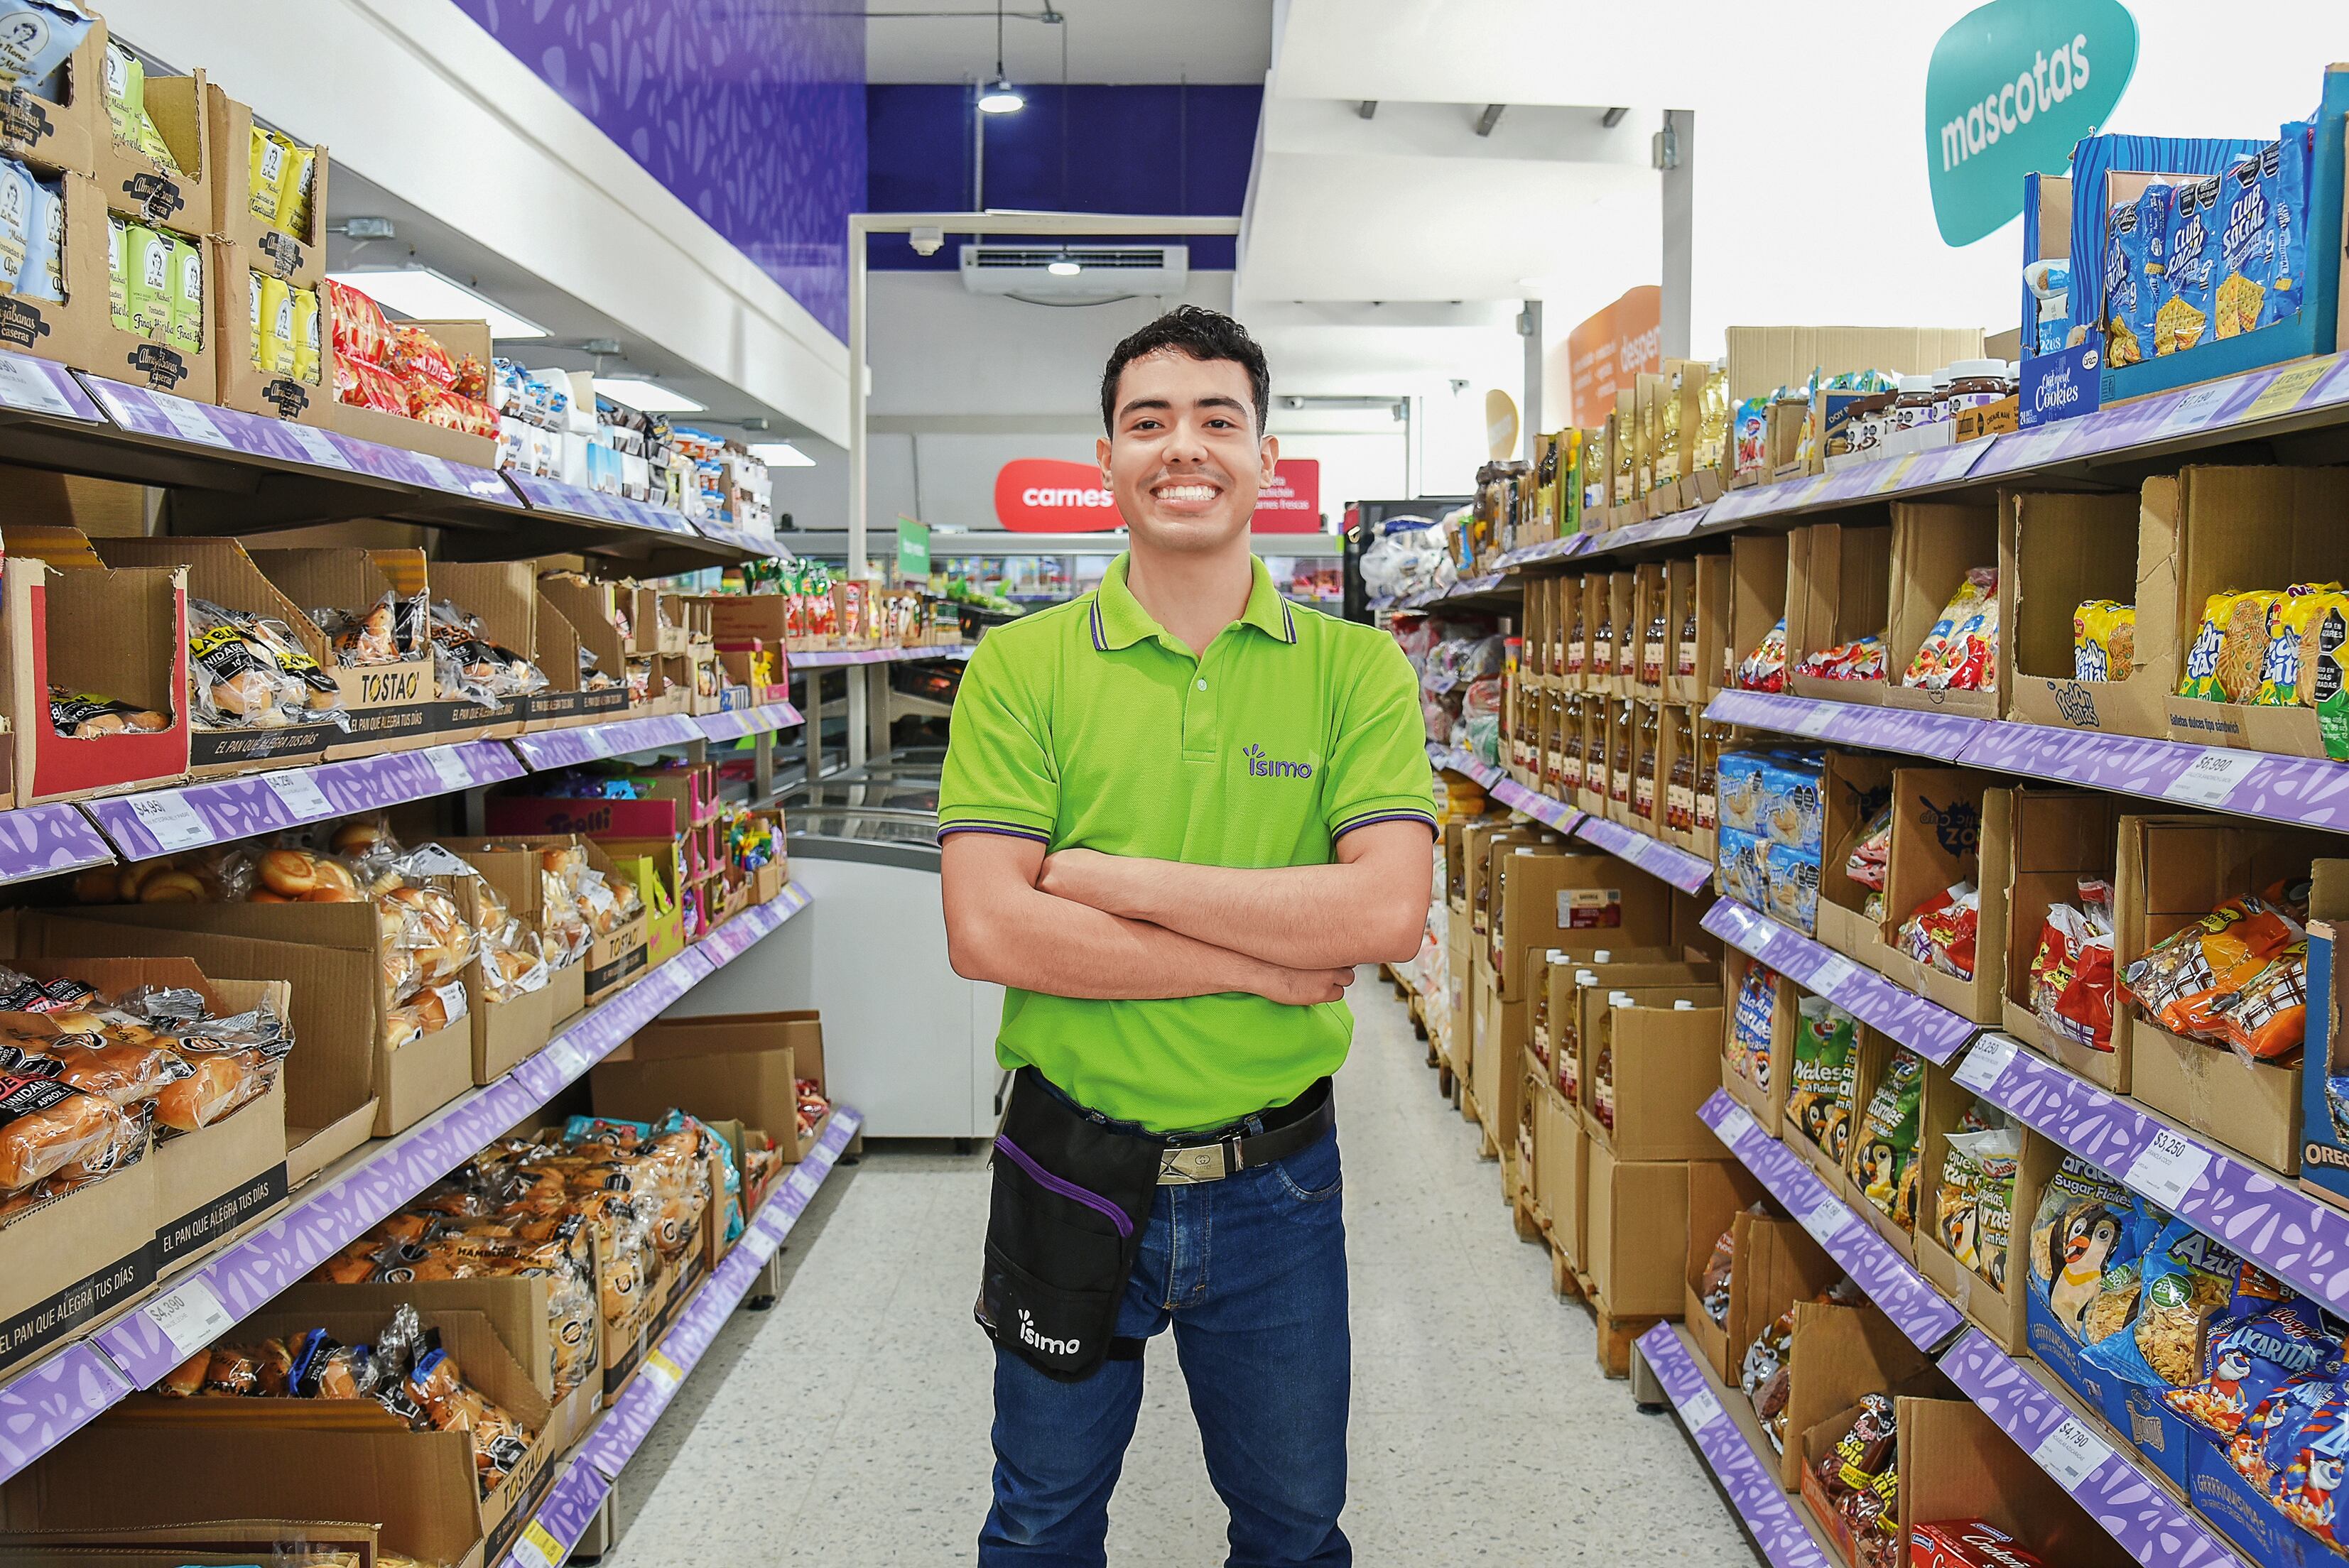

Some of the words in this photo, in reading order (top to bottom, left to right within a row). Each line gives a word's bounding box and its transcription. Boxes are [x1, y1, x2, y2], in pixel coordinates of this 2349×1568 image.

[1941, 33, 2090, 172] mascotas
[2230, 184, 2260, 227] CLUB
[2175, 214, 2201, 254] CLUB
[134, 312, 152, 330] Finas
[1, 327, 30, 342] caseras
[2036, 384, 2078, 413] Cookies
[1023, 488, 1114, 507] carnes
[359, 718, 370, 731] PAN
[370, 717, 381, 730] QUE
[401, 714, 411, 726] TUS
[2170, 714, 2188, 727] Galletas
[2188, 717, 2205, 730] dulces
[2205, 718, 2215, 733] tipo
[215, 742, 225, 754] EL
[226, 740, 241, 753] PAN
[242, 738, 259, 751] QUE
[259, 735, 288, 750] ALEGRA
[288, 736, 301, 747] TUS
[2196, 756, 2233, 772] $6,990
[1975, 1039, 1999, 1055] $3,250
[2154, 1132, 2186, 1158] $3,250
[2055, 1174, 2094, 1194] Sugar
[2095, 1185, 2132, 1207] Flakes
[163, 1236, 173, 1252] EL
[175, 1227, 191, 1247] PAN
[192, 1217, 209, 1238] QUE
[210, 1204, 238, 1231] ALEGRA
[238, 1194, 252, 1214] TUS
[253, 1182, 269, 1206] DÍAS
[0, 1333, 12, 1354] EL
[14, 1321, 33, 1346] PAN
[36, 1310, 55, 1334] QUE
[57, 1291, 94, 1322] ALEGRA
[94, 1279, 112, 1301] TUS
[114, 1265, 134, 1290] DÍAS
[149, 1295, 185, 1321] $4,390
[2266, 1308, 2323, 1341] llogg's
[2060, 1422, 2089, 1448] $4,790
[2220, 1432, 2234, 1442] POR
